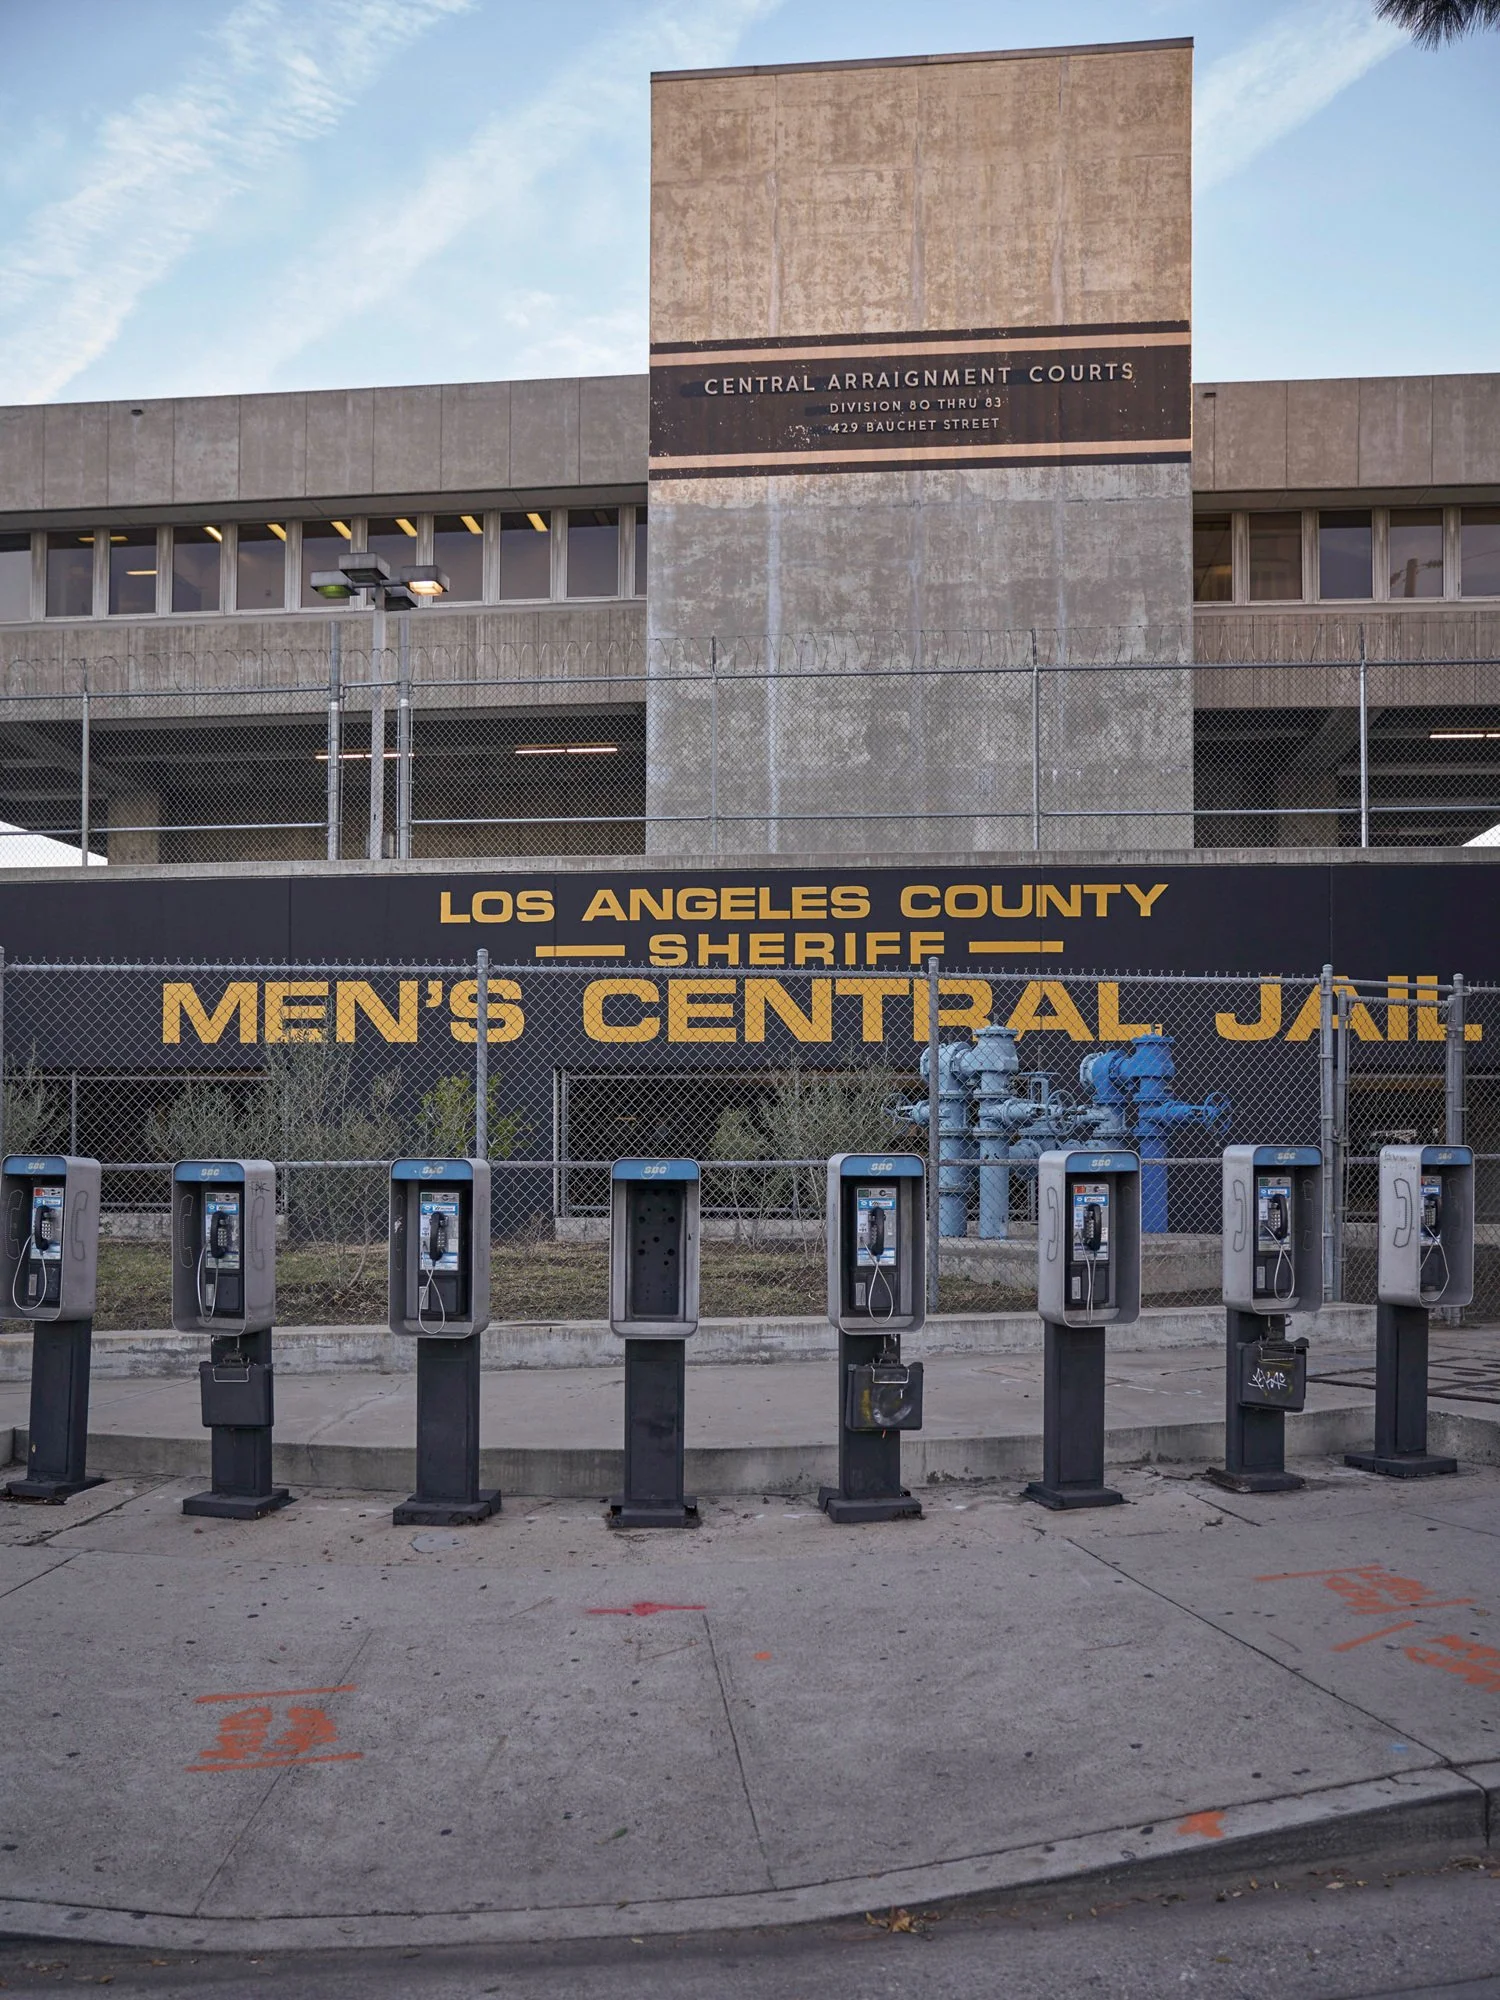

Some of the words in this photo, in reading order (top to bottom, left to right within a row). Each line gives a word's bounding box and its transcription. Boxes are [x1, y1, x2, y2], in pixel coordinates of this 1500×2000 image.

[704, 375, 815, 395] CENTRAL
[827, 367, 1011, 391] ARRAIGNMENT
[1029, 363, 1134, 383] COURTS
[830, 401, 901, 414] DIVISION
[909, 400, 930, 411] 80
[938, 398, 977, 409] THRU
[985, 397, 1001, 409] 83
[831, 422, 858, 434] 429
[866, 420, 937, 433] BAUCHET
[943, 418, 1000, 431] STREET
[440, 889, 556, 924] LOS
[583, 885, 871, 921] ANGELES
[900, 884, 1168, 919] COUNTY
[649, 931, 945, 967] SHERIFF
[162, 979, 526, 1044] MEN'S
[582, 977, 1163, 1043] CENTRAL
[1215, 975, 1483, 1042] JAIL
